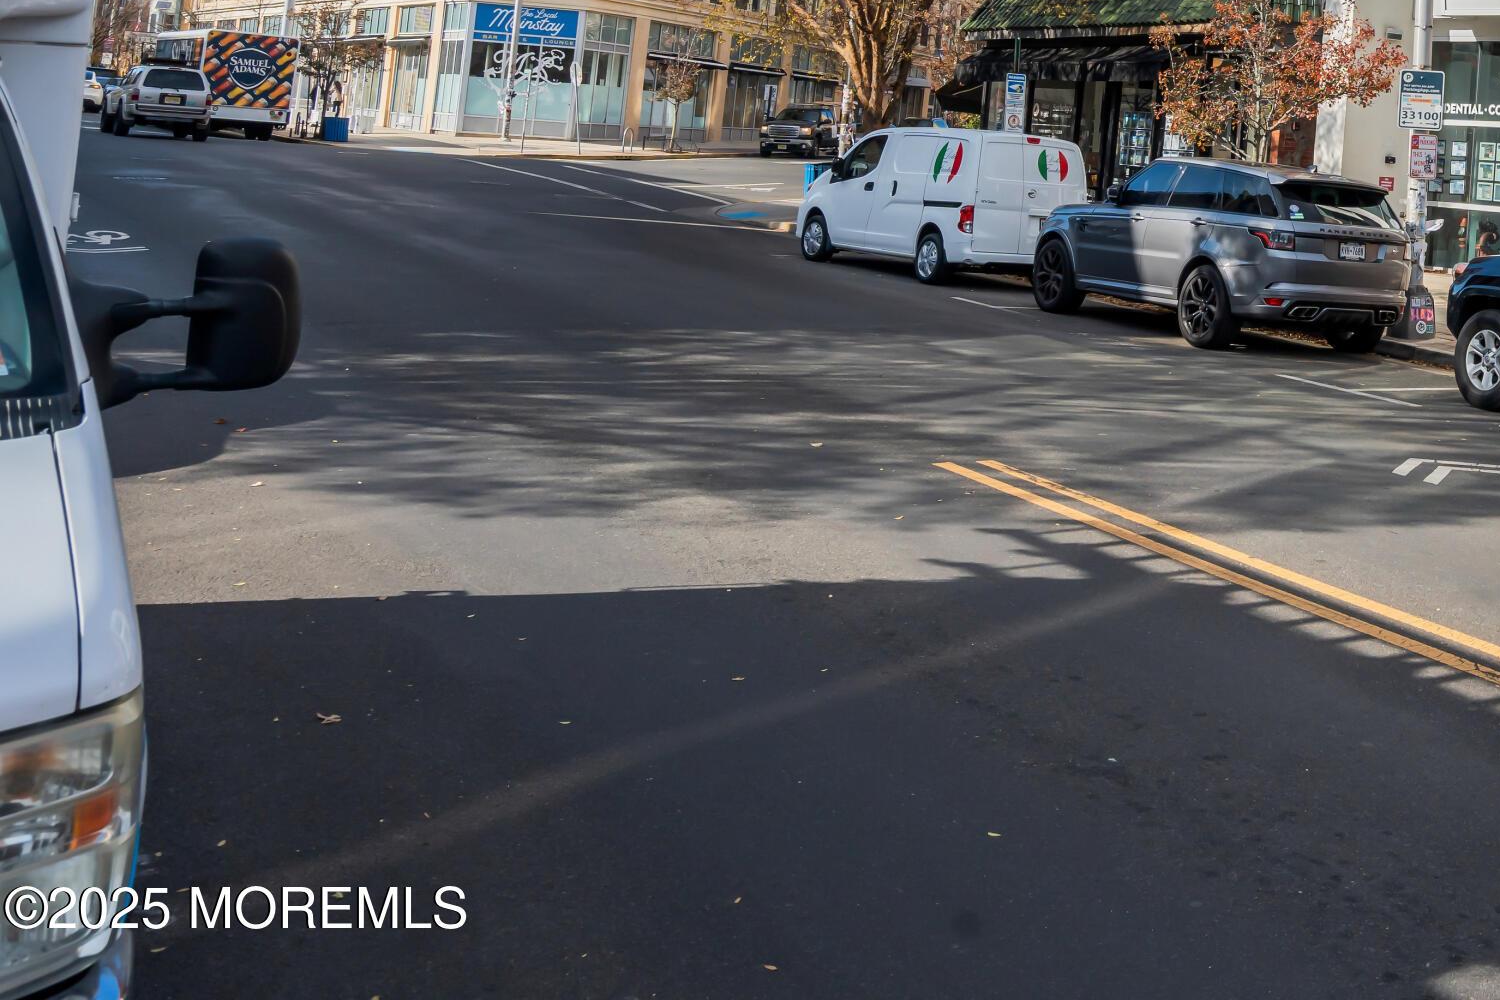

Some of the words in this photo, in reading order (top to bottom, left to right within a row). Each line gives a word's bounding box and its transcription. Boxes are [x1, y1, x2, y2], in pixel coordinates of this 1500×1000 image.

[521, 8, 534, 18] The
[535, 8, 558, 19] Local
[230, 56, 272, 68] SAMUEL
[232, 65, 266, 76] ADAMS
[1444, 103, 1484, 116] DENTIAL
[1402, 111, 1438, 120] 33100
